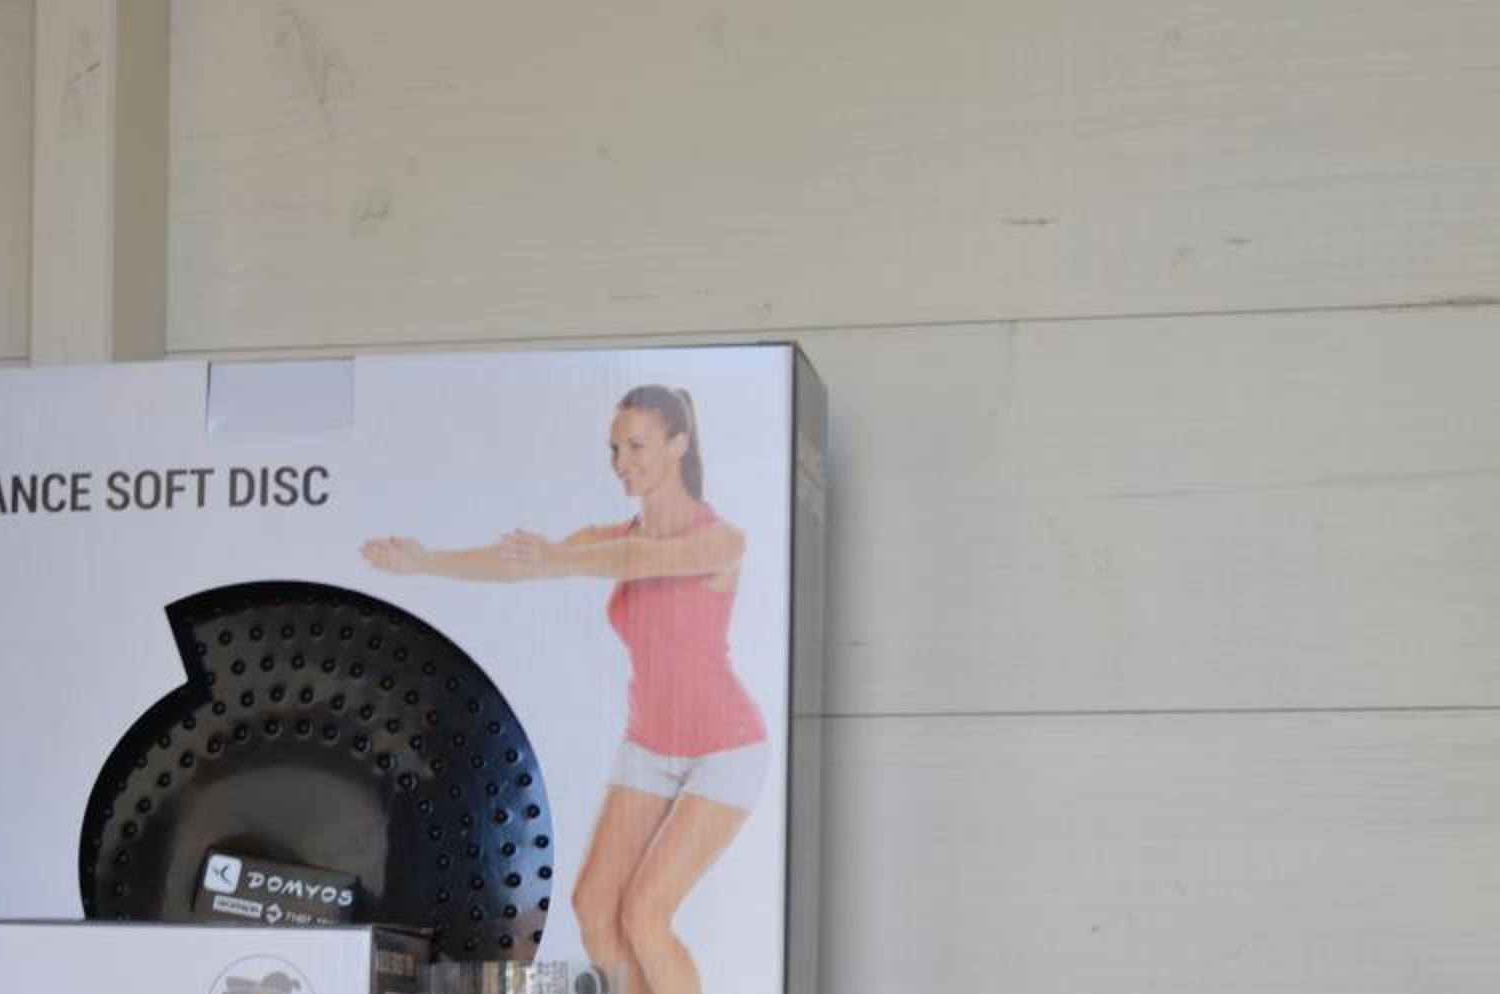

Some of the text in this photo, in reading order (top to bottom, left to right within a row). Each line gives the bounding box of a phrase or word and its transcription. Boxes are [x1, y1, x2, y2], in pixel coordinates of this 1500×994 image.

[106, 468, 215, 511] SOFT
[228, 466, 330, 507] DISC
[247, 870, 354, 907] DOMYOS
